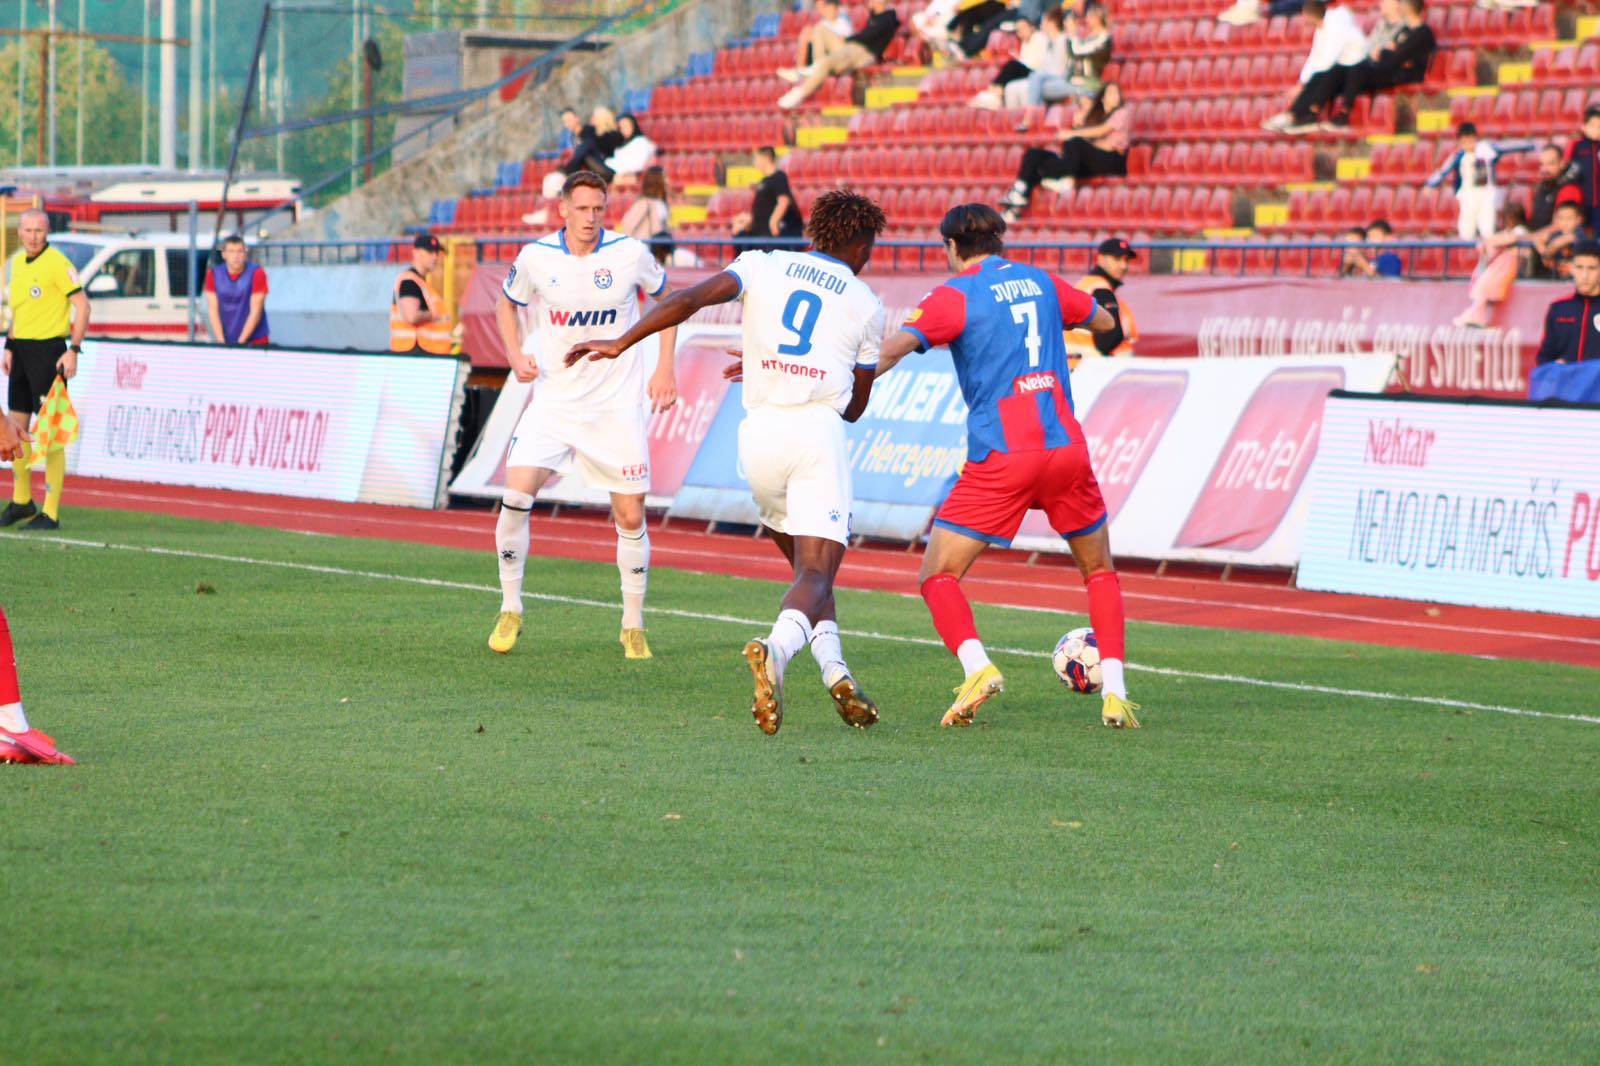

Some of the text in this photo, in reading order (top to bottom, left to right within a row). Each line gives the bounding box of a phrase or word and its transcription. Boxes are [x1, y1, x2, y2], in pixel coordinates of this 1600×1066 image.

[785, 262, 847, 295] CHINEDU
[777, 289, 823, 356] 9
[1010, 301, 1042, 367] 7
[1215, 420, 1319, 491] m:tel
[1364, 417, 1436, 467] Nektar
